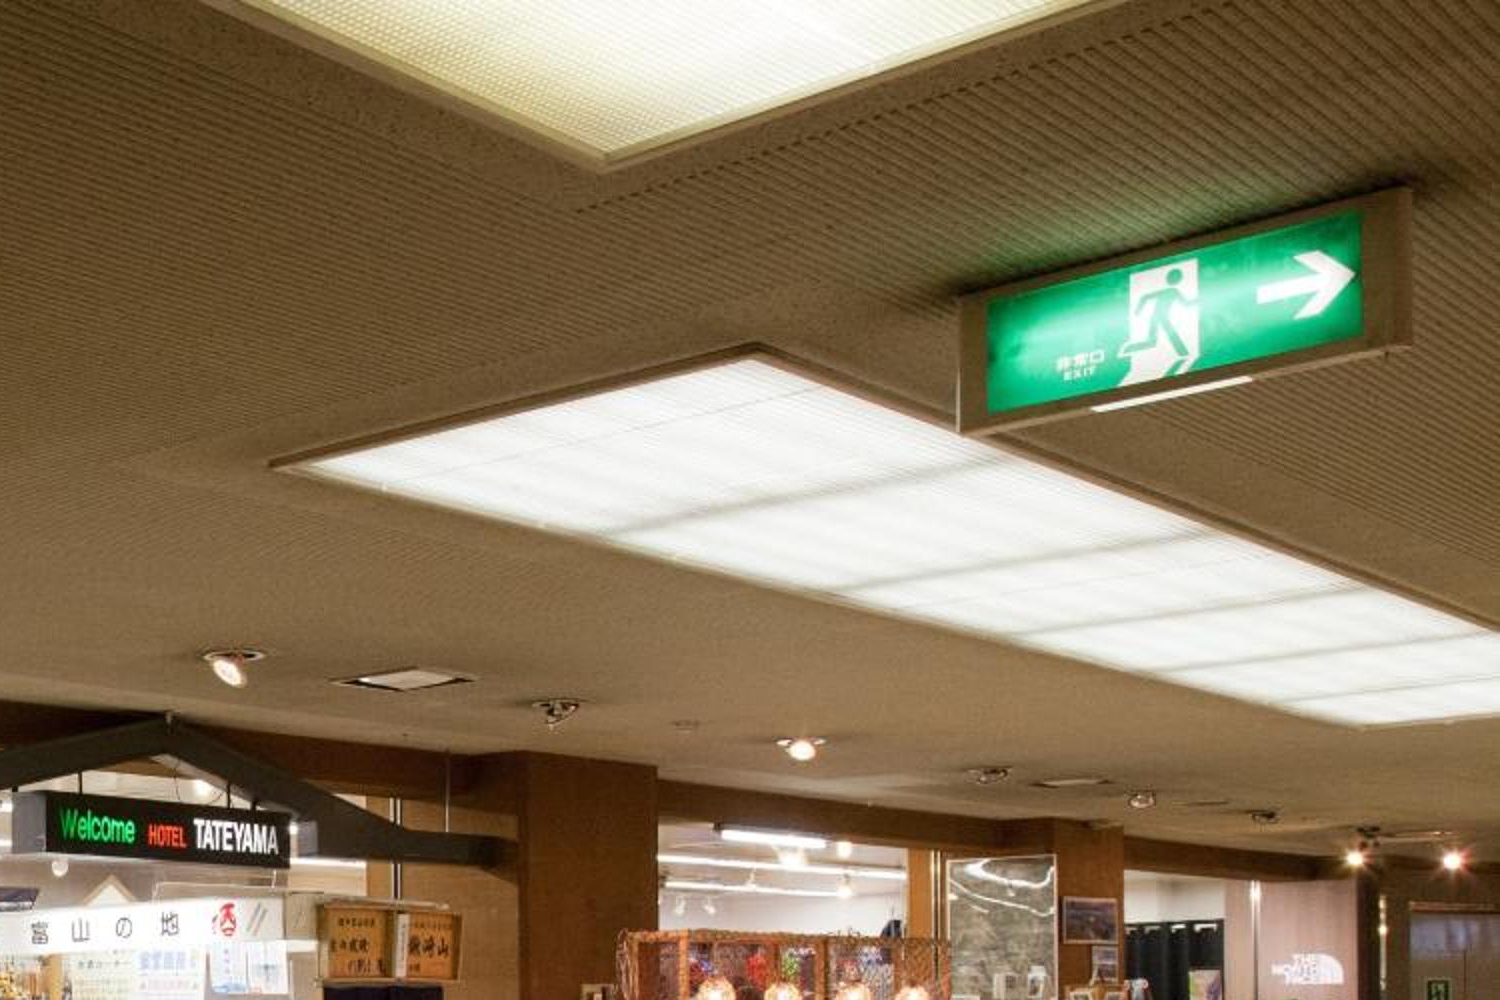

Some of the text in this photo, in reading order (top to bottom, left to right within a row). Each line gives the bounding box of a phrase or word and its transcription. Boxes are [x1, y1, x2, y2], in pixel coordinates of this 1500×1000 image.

[60, 808, 279, 855] Welcome HOTEL TATEYAMA
